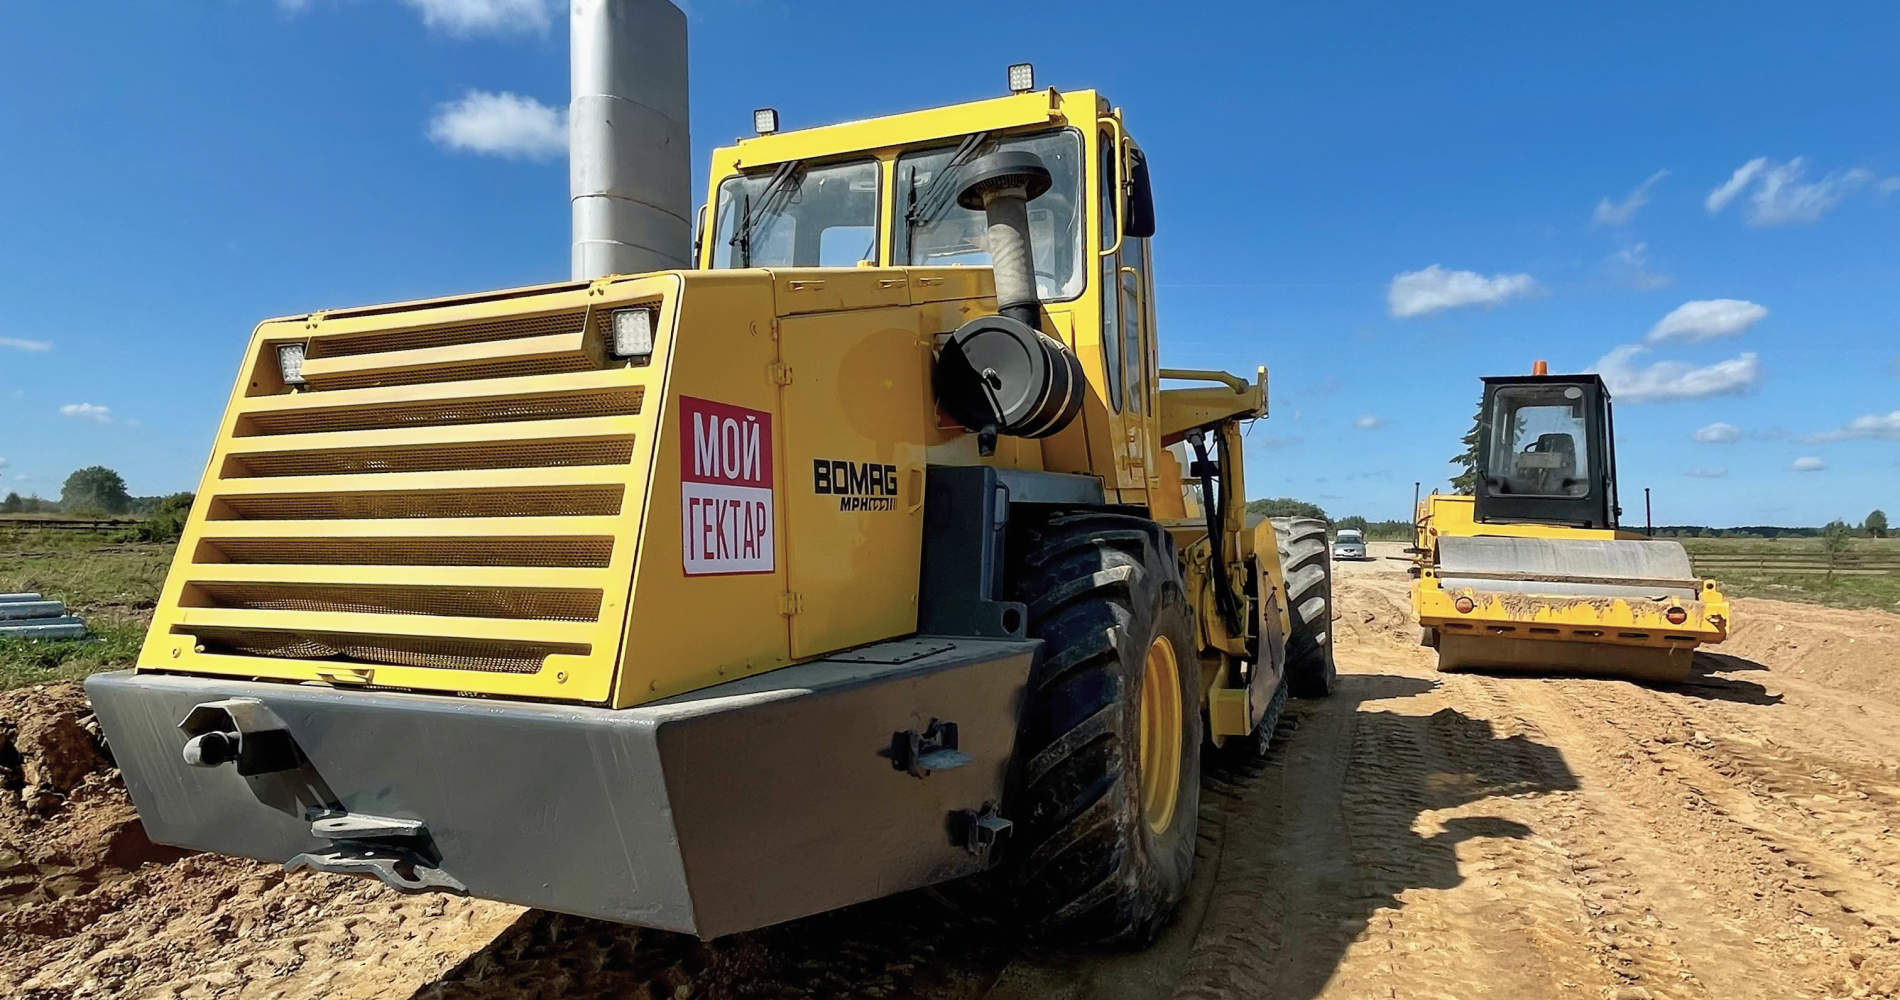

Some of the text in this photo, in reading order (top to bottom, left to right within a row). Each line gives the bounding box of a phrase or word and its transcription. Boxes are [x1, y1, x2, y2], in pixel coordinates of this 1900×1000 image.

[693, 411, 761, 482] МОЙ
[813, 458, 898, 496] BOMAG
[688, 497, 767, 561] ГЕКТАР
